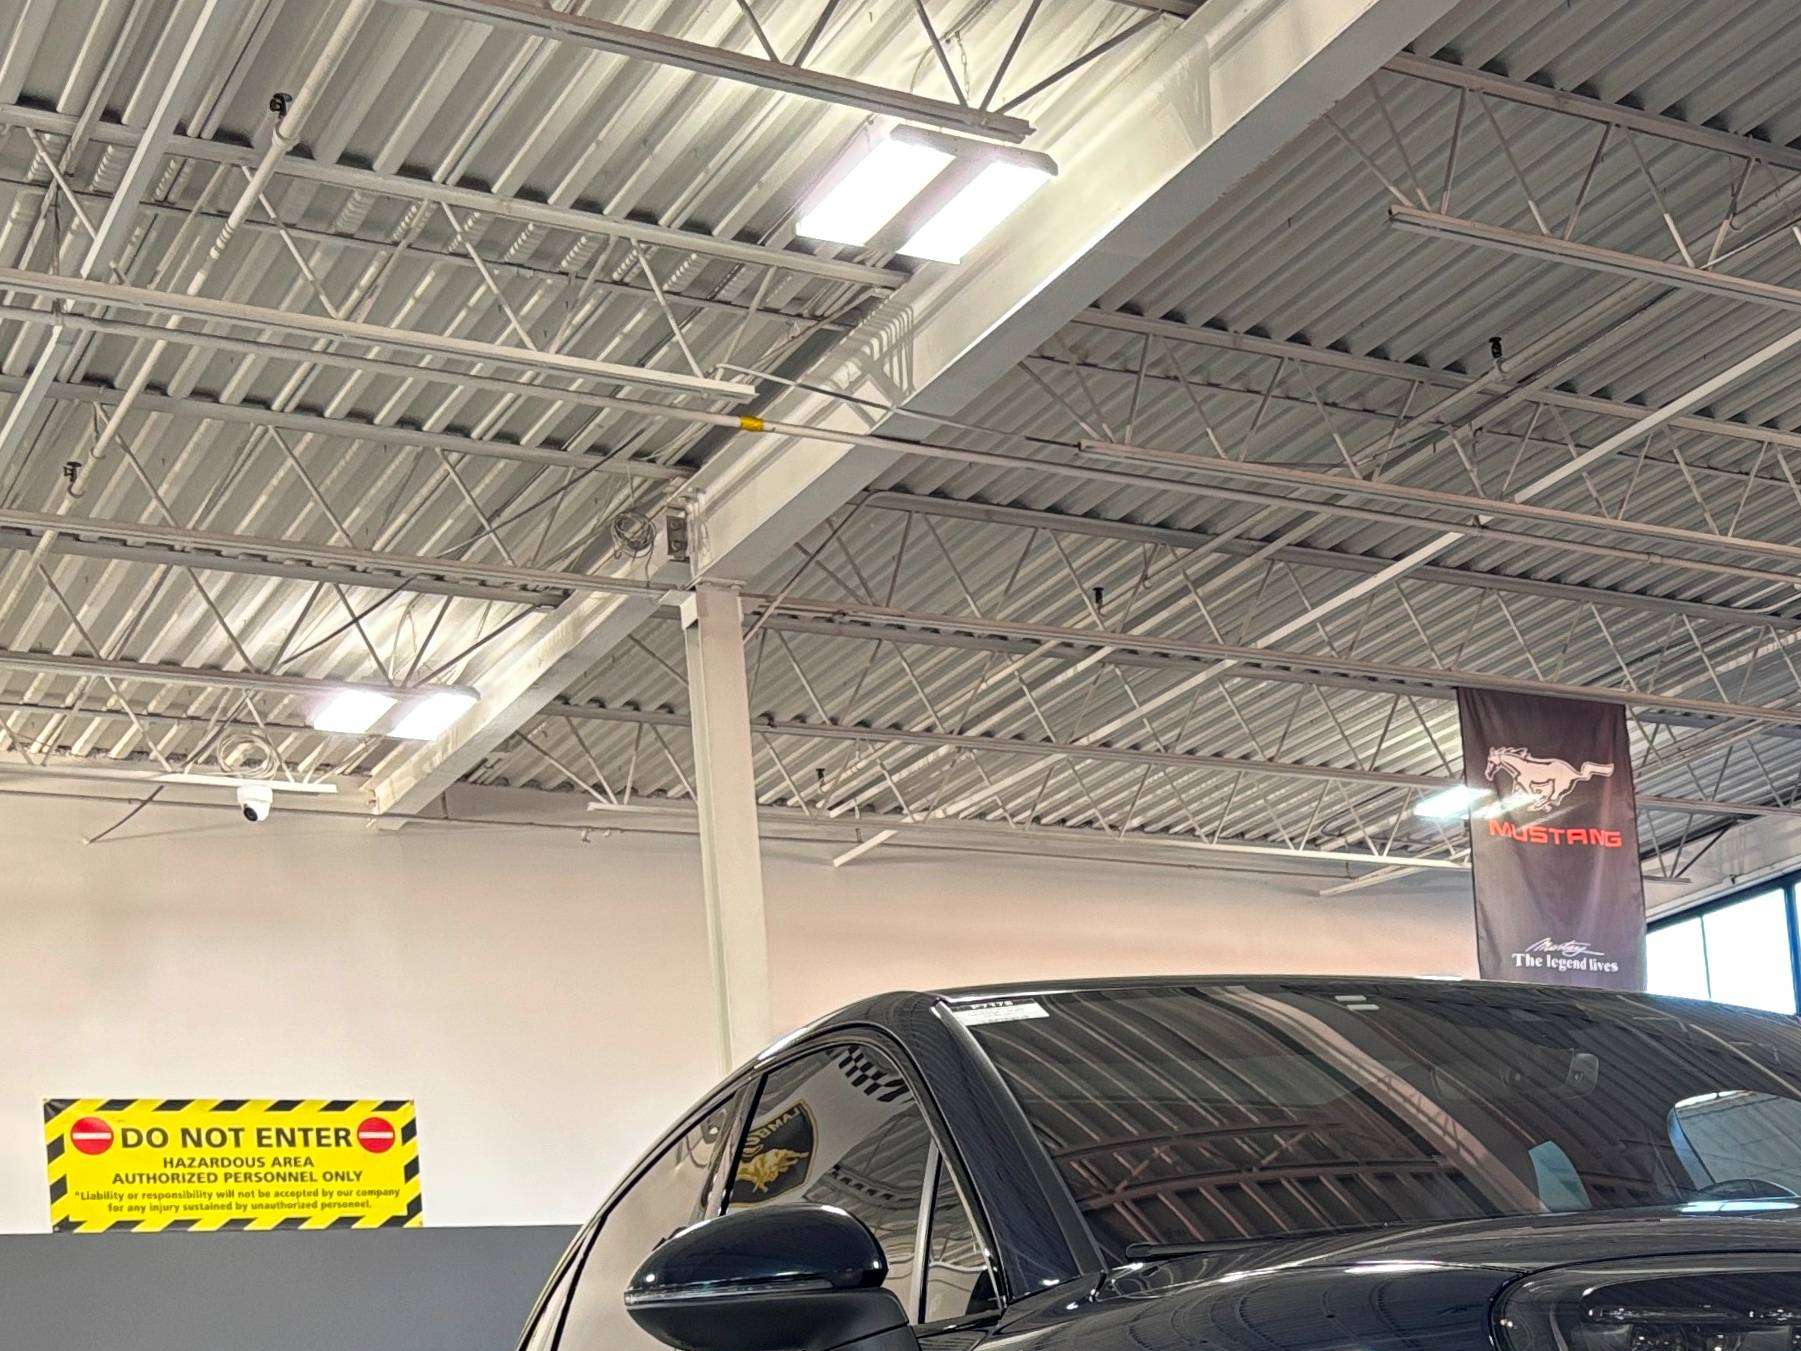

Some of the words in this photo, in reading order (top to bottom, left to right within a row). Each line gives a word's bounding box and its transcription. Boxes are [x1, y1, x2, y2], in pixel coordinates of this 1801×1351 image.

[1488, 818, 1622, 849] MUSTANG
[1511, 953, 1543, 968] The
[1546, 954, 1587, 972] legend
[1589, 958, 1619, 973] lives
[121, 1127, 169, 1149] DO
[181, 1127, 245, 1149] NOT
[256, 1127, 352, 1148] ENTER
[163, 1156, 265, 1169] HAZARDOUS
[271, 1156, 314, 1168] AREA
[112, 1172, 218, 1184] AUTHORIZED
[224, 1171, 317, 1183] PERSONNEL
[322, 1170, 363, 1182] ONLY
[142, 1190, 213, 1201] responsibility
[216, 1190, 235, 1199] will
[238, 1190, 255, 1198] not
[258, 1189, 271, 1198] be
[274, 1188, 319, 1200] accepted
[322, 1188, 334, 1199] by
[356, 1189, 400, 1198] company
[108, 1203, 123, 1212] for
[127, 1205, 146, 1214] any
[150, 1203, 180, 1214] injury
[183, 1202, 233, 1212] sustained
[236, 1202, 247, 1212] by
[251, 1201, 318, 1211] unauthorized
